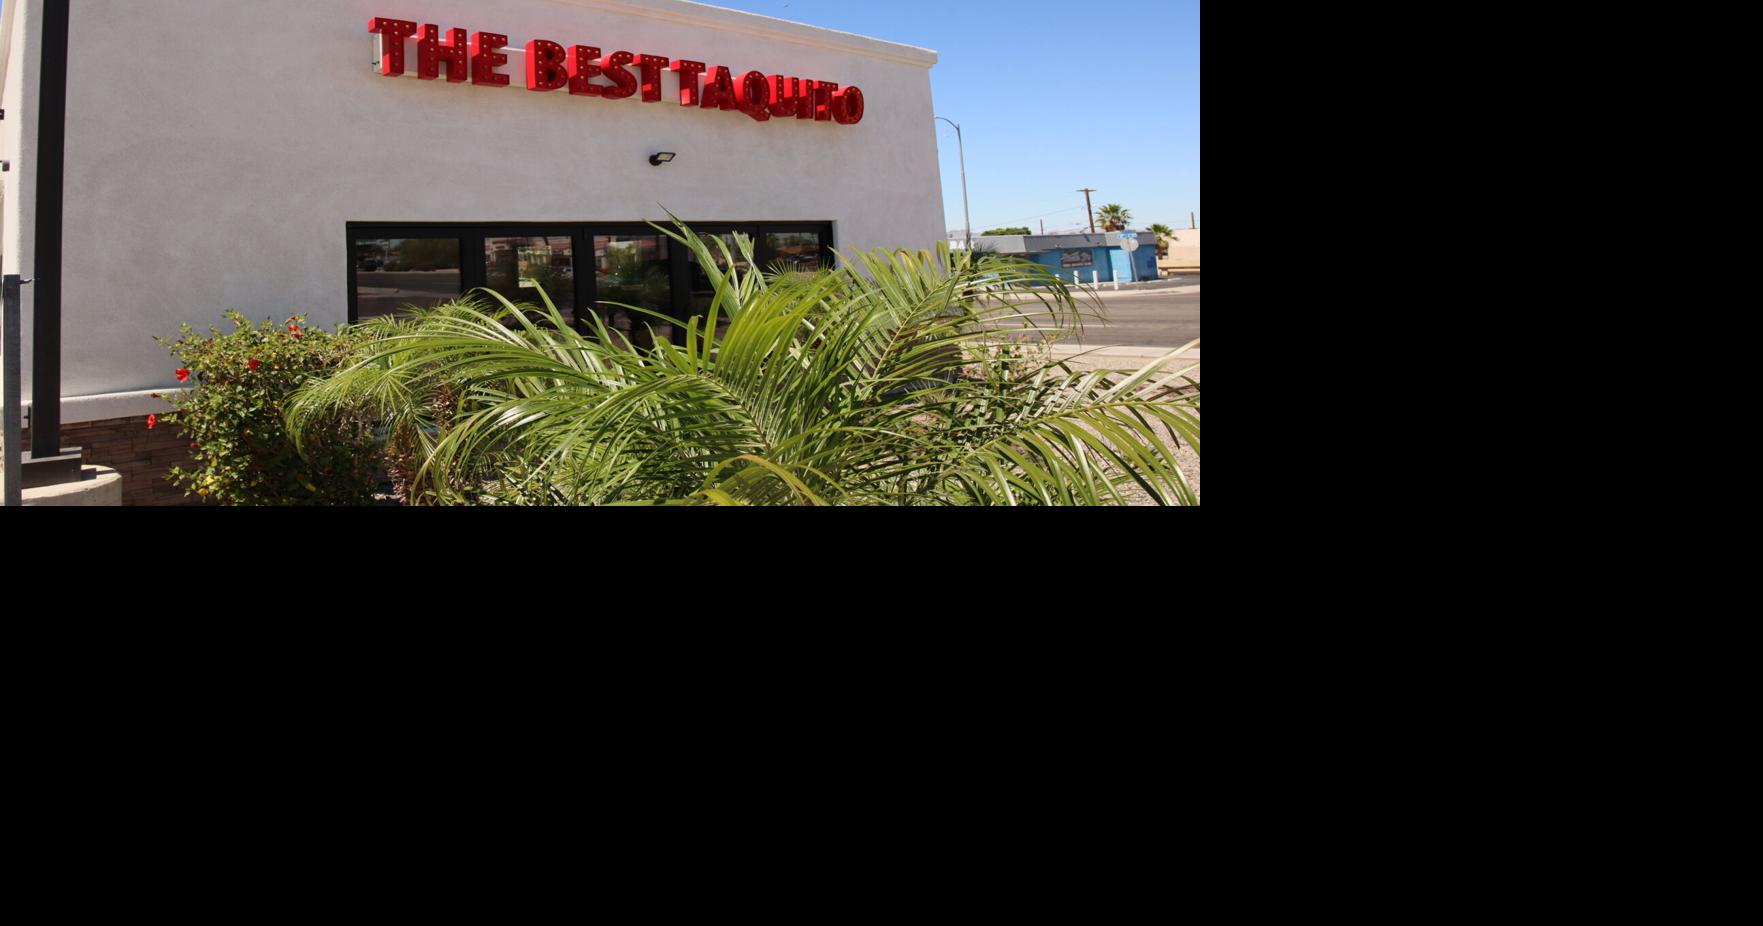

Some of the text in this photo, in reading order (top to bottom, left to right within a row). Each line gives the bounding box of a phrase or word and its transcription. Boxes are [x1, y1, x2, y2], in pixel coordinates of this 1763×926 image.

[368, 17, 865, 125] THE BEST TAQUITO
